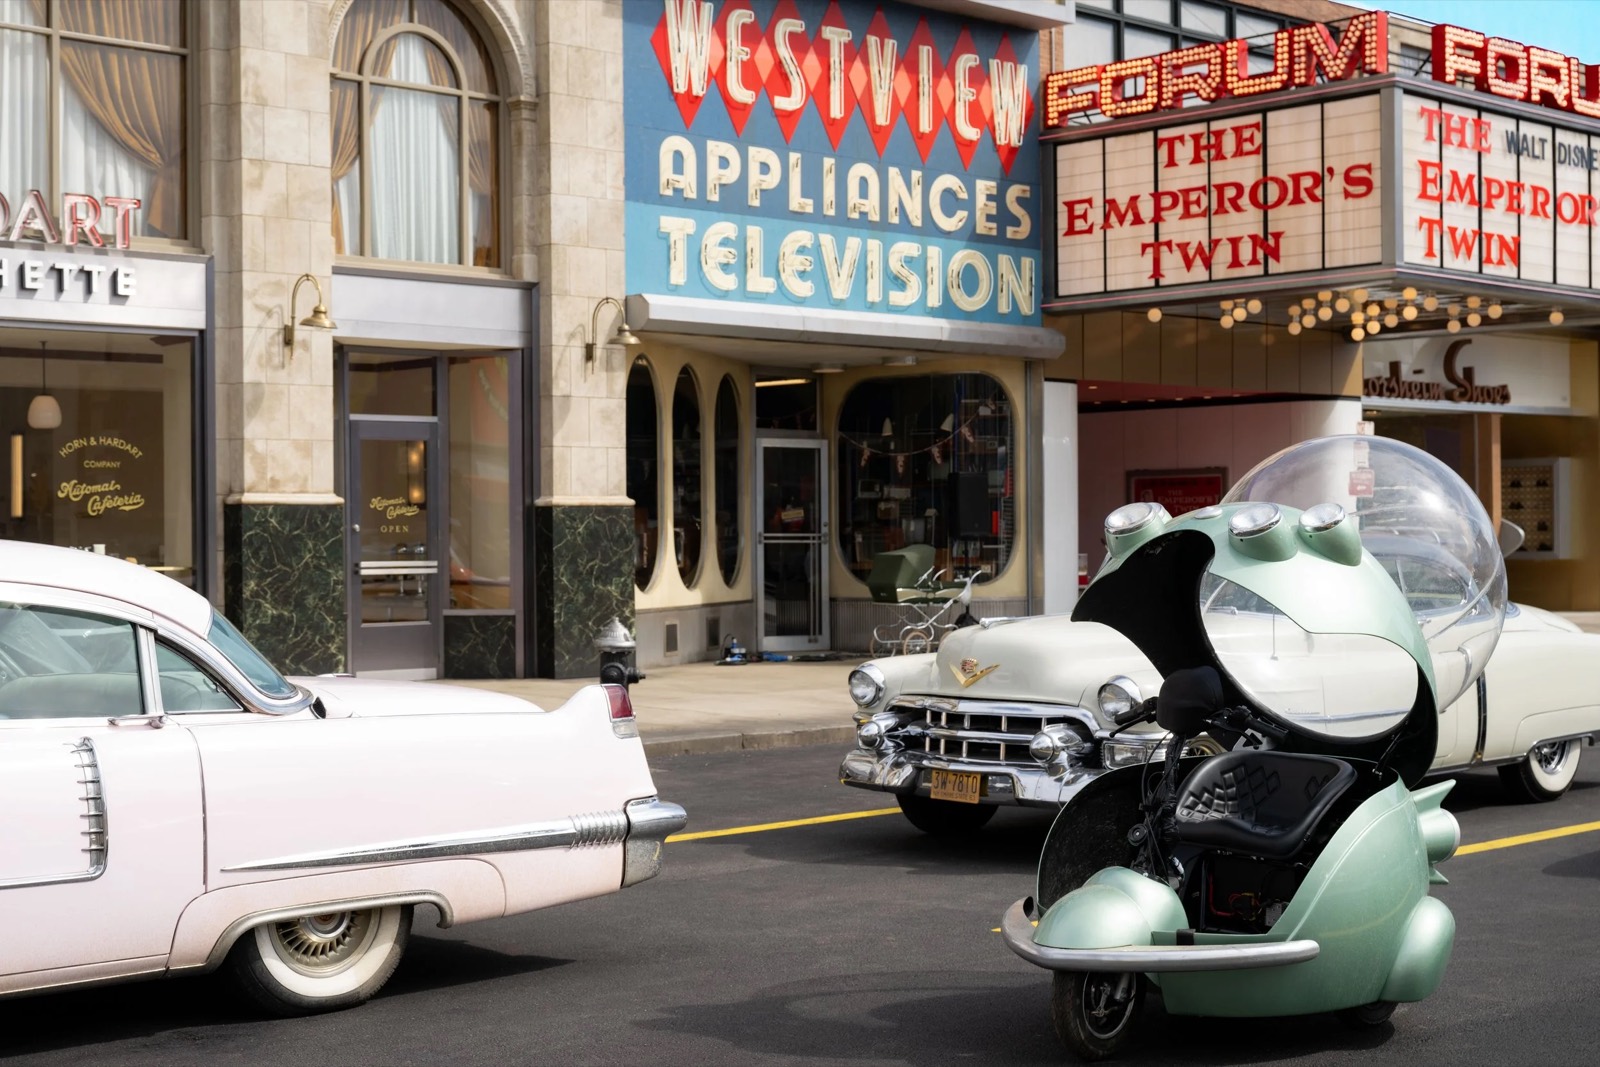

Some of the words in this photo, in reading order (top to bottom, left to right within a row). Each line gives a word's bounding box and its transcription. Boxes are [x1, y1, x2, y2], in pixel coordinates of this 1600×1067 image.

[665, 0, 1028, 148] WESTVIEW
[1045, 10, 1389, 128] FORUM
[1157, 121, 1262, 169] THE
[1420, 106, 1492, 154] THE
[1505, 129, 1548, 160] WALT
[1558, 142, 1600, 171] DISNE
[659, 135, 1032, 241] APPLIANCES
[1062, 163, 1374, 237] EMPEROR'S
[0, 189, 141, 249] ART
[1418, 216, 1521, 268] TWIN
[659, 215, 1035, 316] TELEVISION
[1141, 231, 1285, 280] TWIN
[1364, 361, 1444, 402] orsheim
[1443, 339, 1511, 405] Shoes
[59, 437, 88, 458] HORN
[89, 436, 97, 446] &
[99, 436, 143, 459] HARDART
[83, 460, 121, 468] COMPANY
[57, 479, 121, 501] Automat
[87, 492, 145, 516] Cafeteria
[380, 525, 409, 533] OPEN
